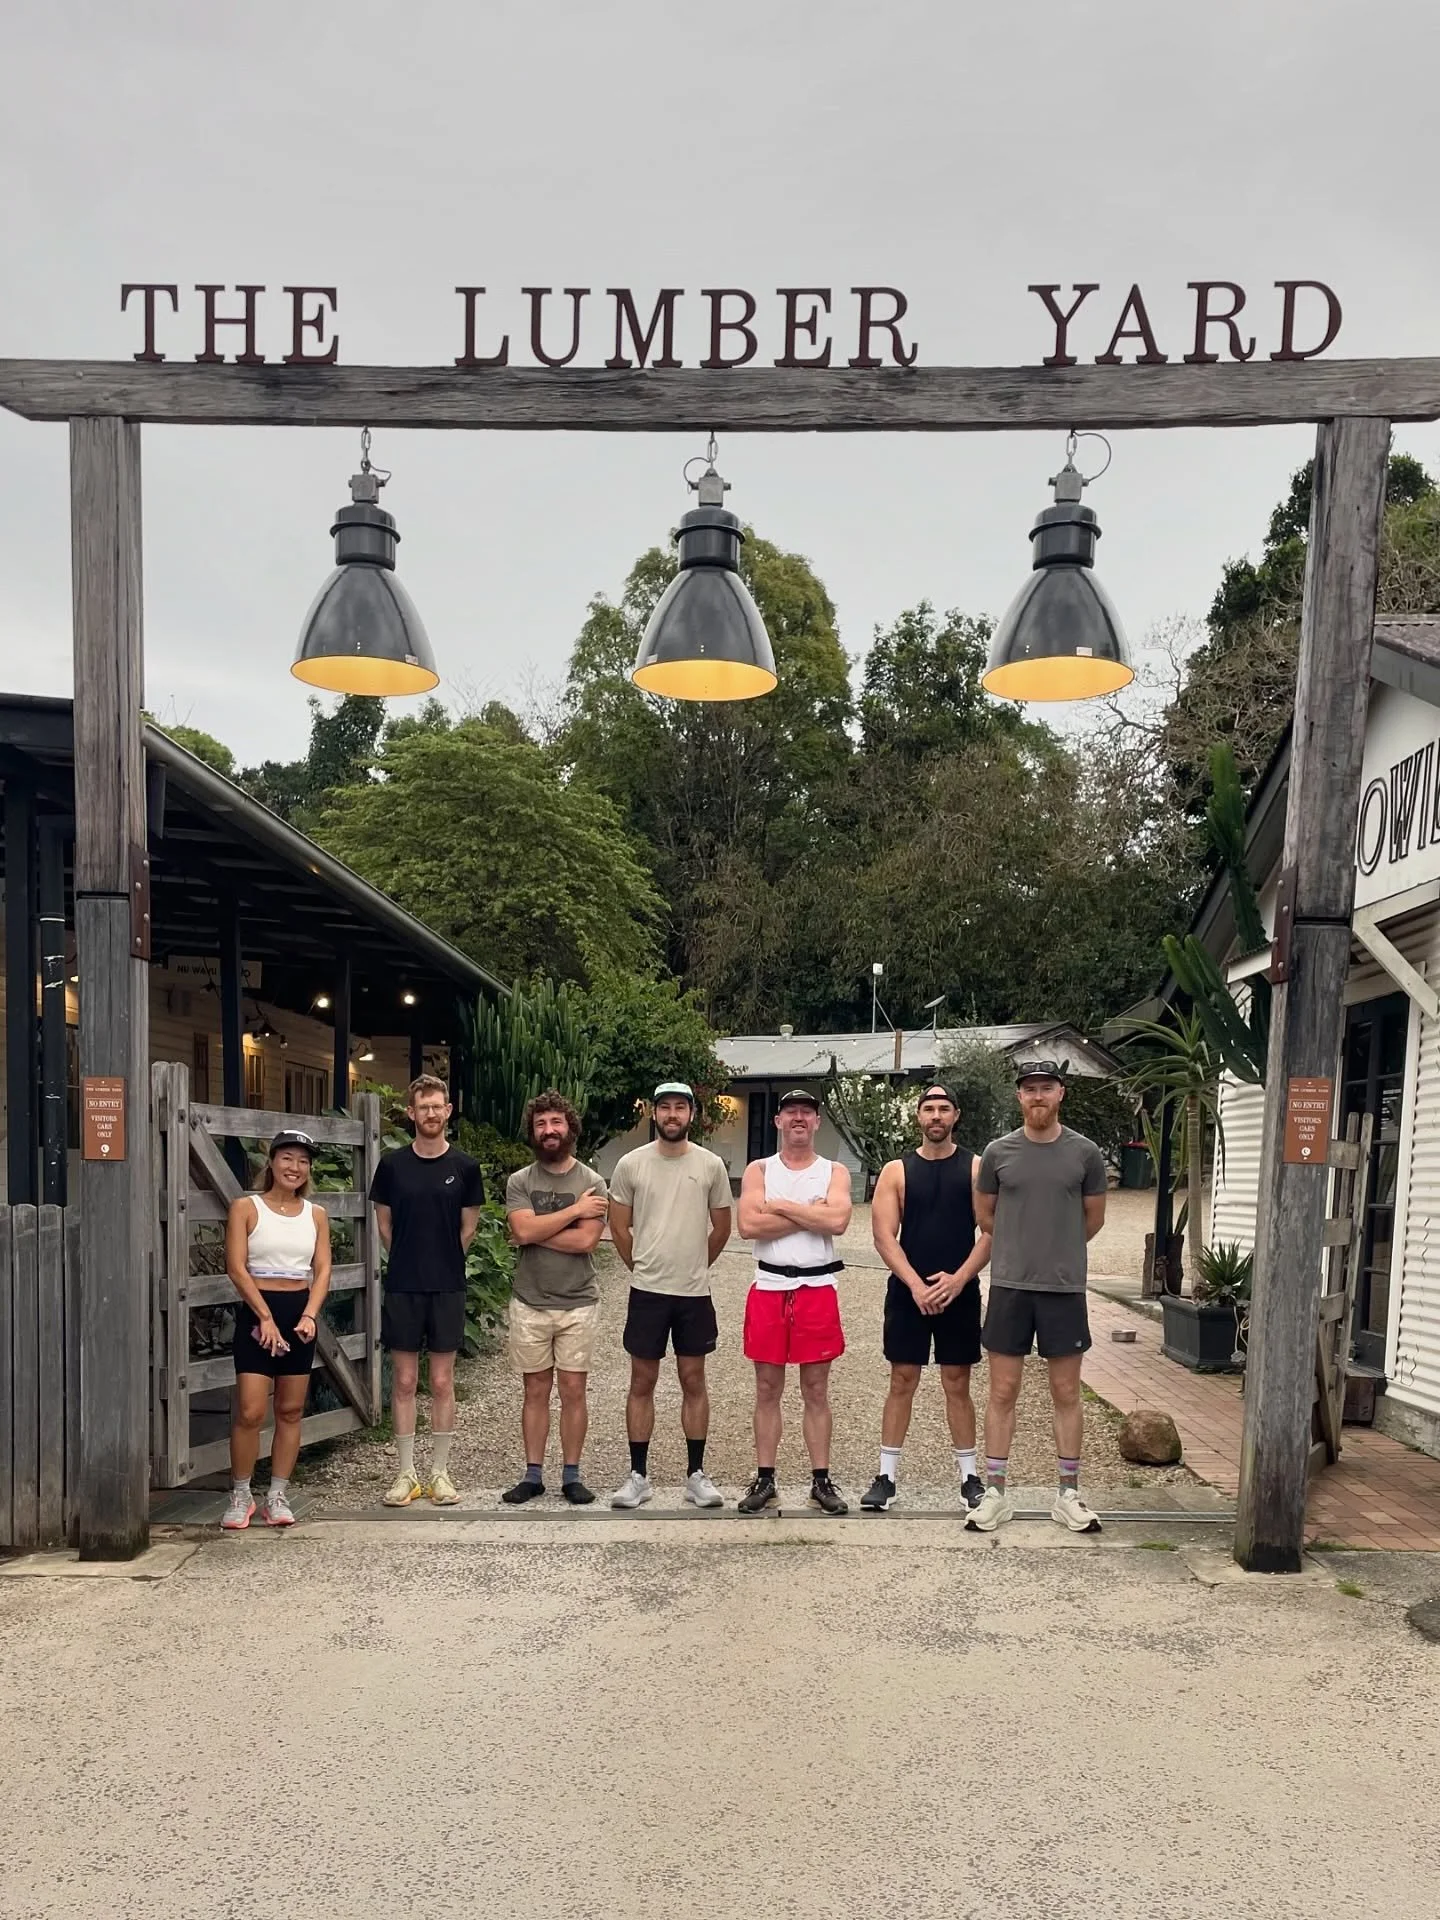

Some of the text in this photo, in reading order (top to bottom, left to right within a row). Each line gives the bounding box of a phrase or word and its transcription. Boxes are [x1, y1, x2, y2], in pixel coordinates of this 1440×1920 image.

[121, 280, 1343, 369] THE LUMBER YARD
[88, 1100, 120, 1108] NO ENTRY
[1292, 1101, 1326, 1110] NO ENTRY
[91, 1114, 118, 1122] VISITORS
[1293, 1116, 1322, 1124] VISITORS
[1298, 1133, 1315, 1141] ONLY
